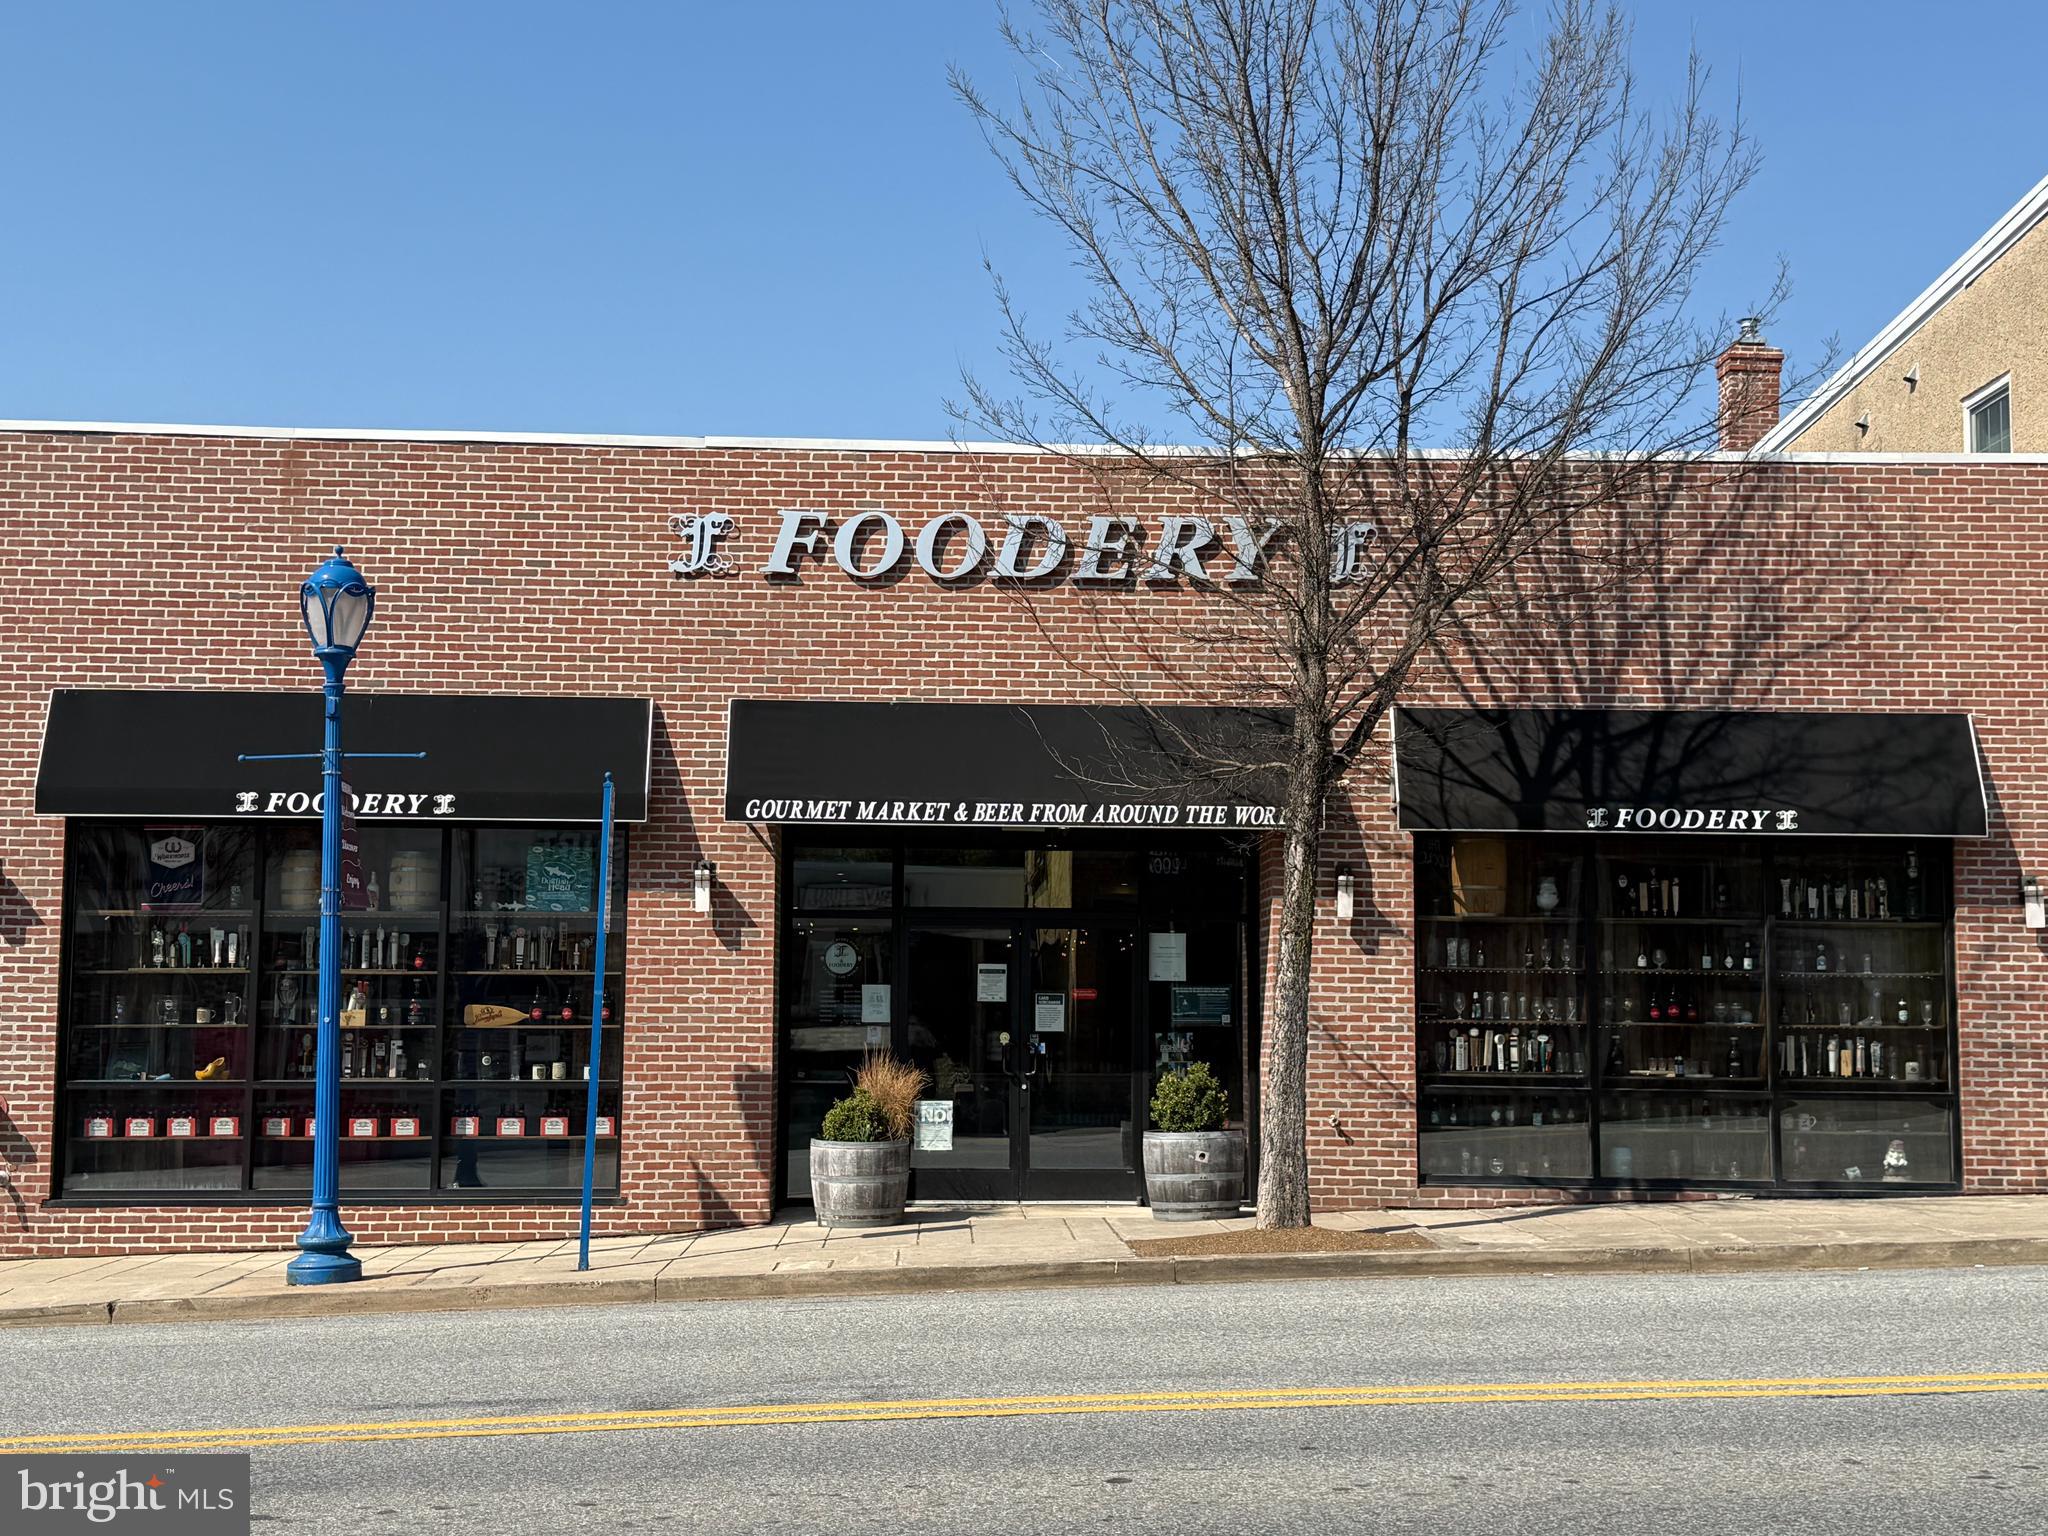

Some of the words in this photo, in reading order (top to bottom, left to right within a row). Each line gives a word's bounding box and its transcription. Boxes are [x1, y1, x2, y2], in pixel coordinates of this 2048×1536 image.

[759, 510, 1282, 581] FOODERY
[745, 799, 852, 820] GOURMET
[856, 801, 950, 822] MARKET
[953, 802, 969, 822] &
[972, 803, 1025, 823] BEER
[1029, 803, 1088, 823] FROM
[1091, 805, 1180, 825] AROUND
[1185, 805, 1228, 825] THE
[1614, 807, 1772, 830] FOODERY
